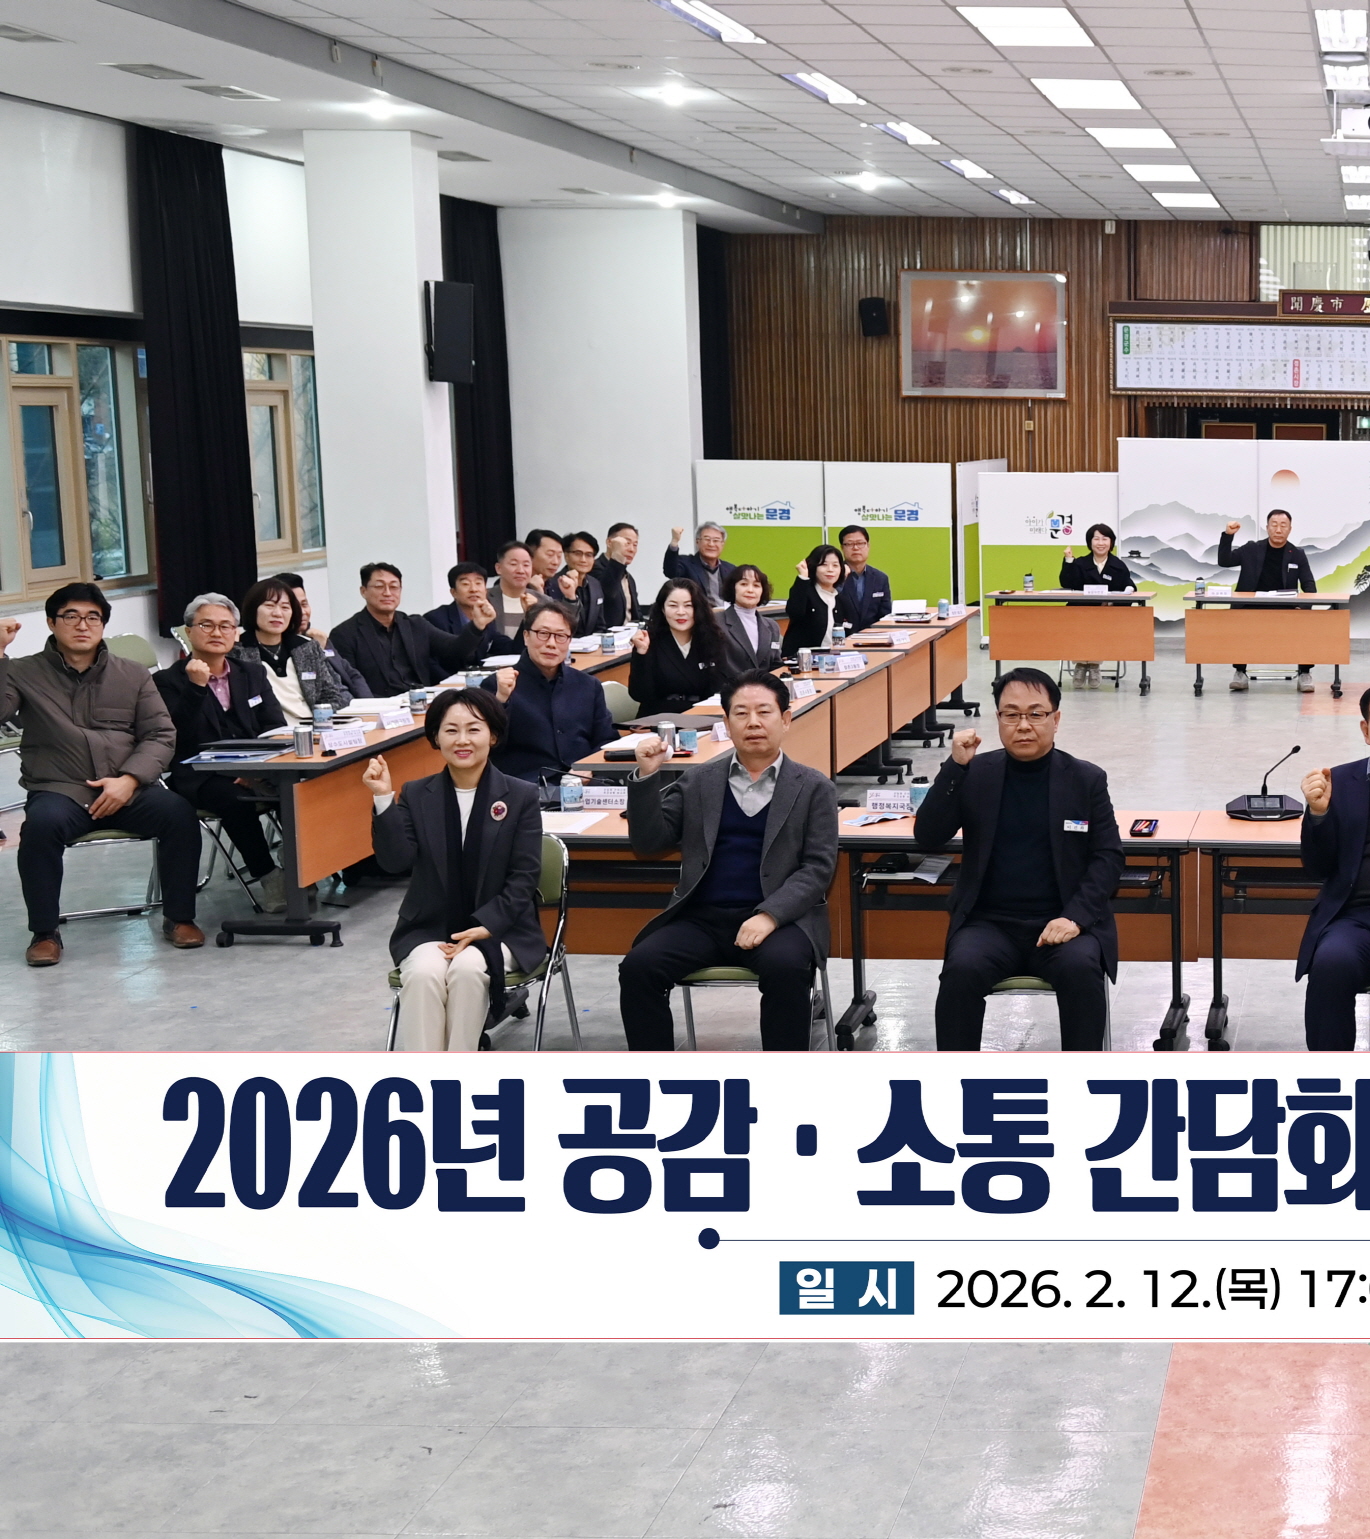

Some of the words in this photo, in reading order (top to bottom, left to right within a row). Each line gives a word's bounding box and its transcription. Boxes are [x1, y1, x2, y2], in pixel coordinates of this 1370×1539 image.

[765, 508, 791, 520] 문경
[894, 509, 919, 521] 문경
[583, 798, 625, 806] 업기술센터소장
